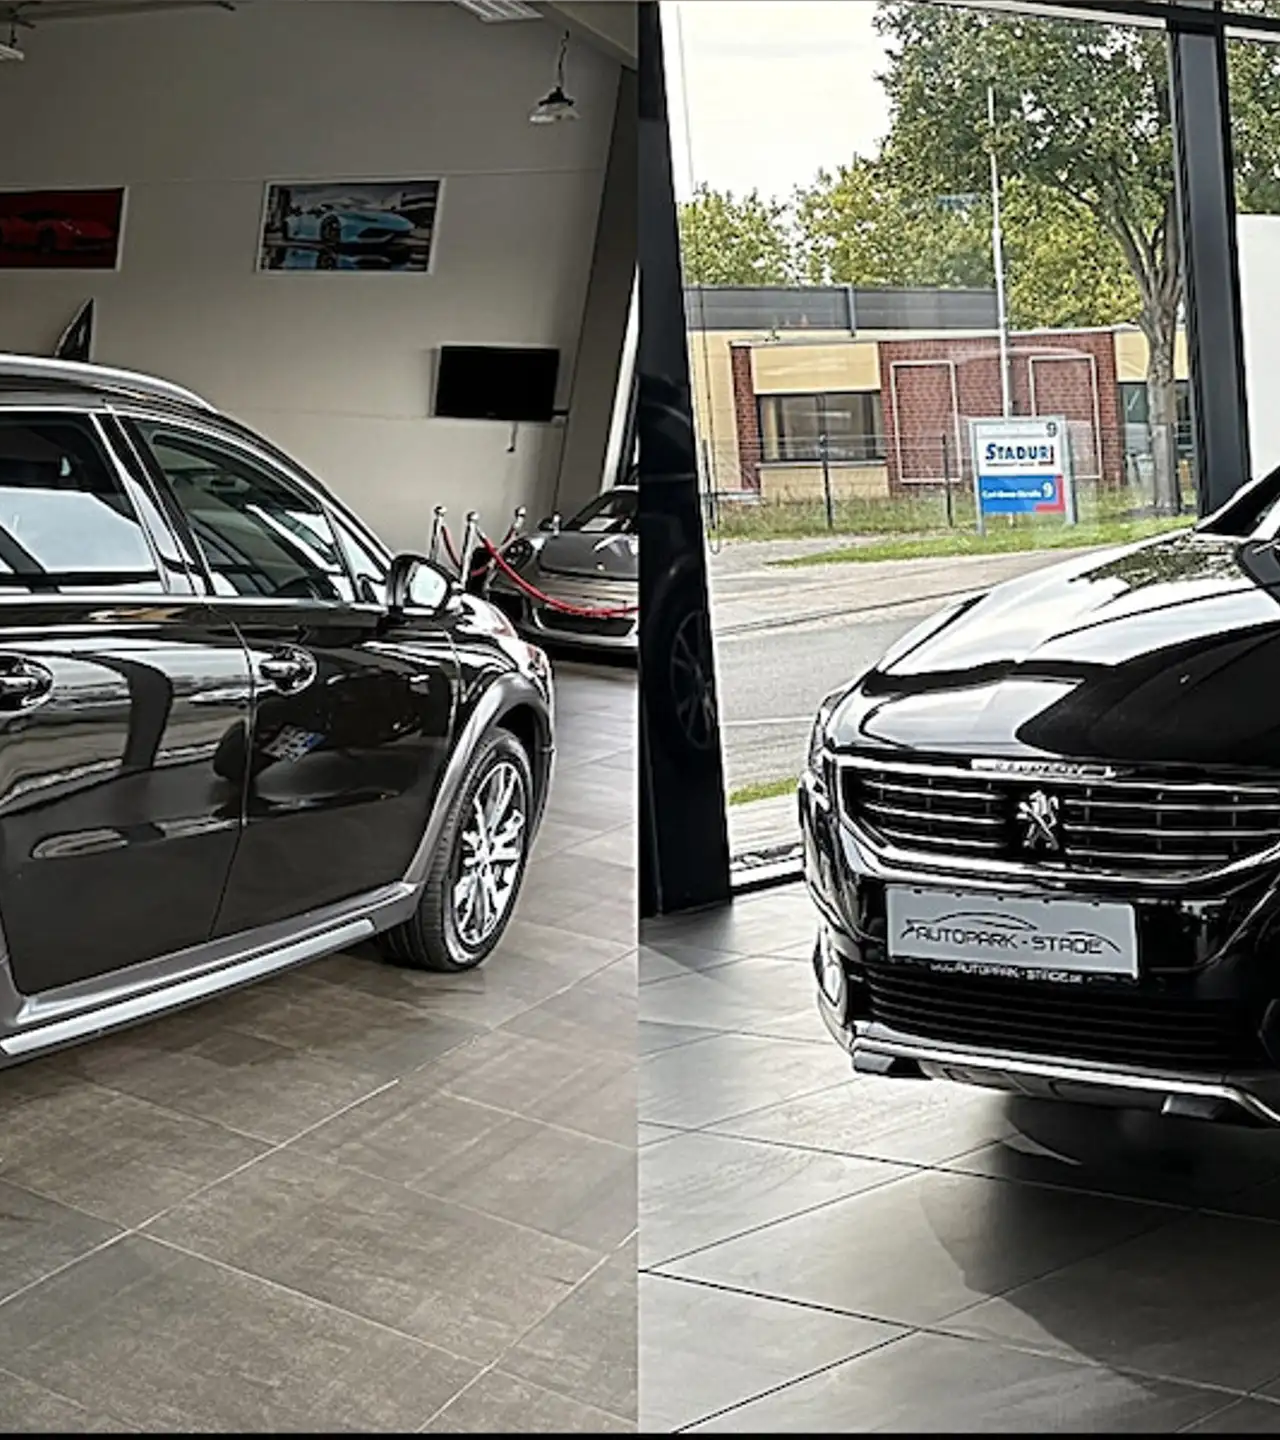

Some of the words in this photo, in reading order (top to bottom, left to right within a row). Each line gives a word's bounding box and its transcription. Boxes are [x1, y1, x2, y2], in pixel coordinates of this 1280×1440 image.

[1046, 421, 1058, 438] 9
[915, 927, 1019, 951] AUTOPARK
[1031, 935, 1104, 955] STADE
